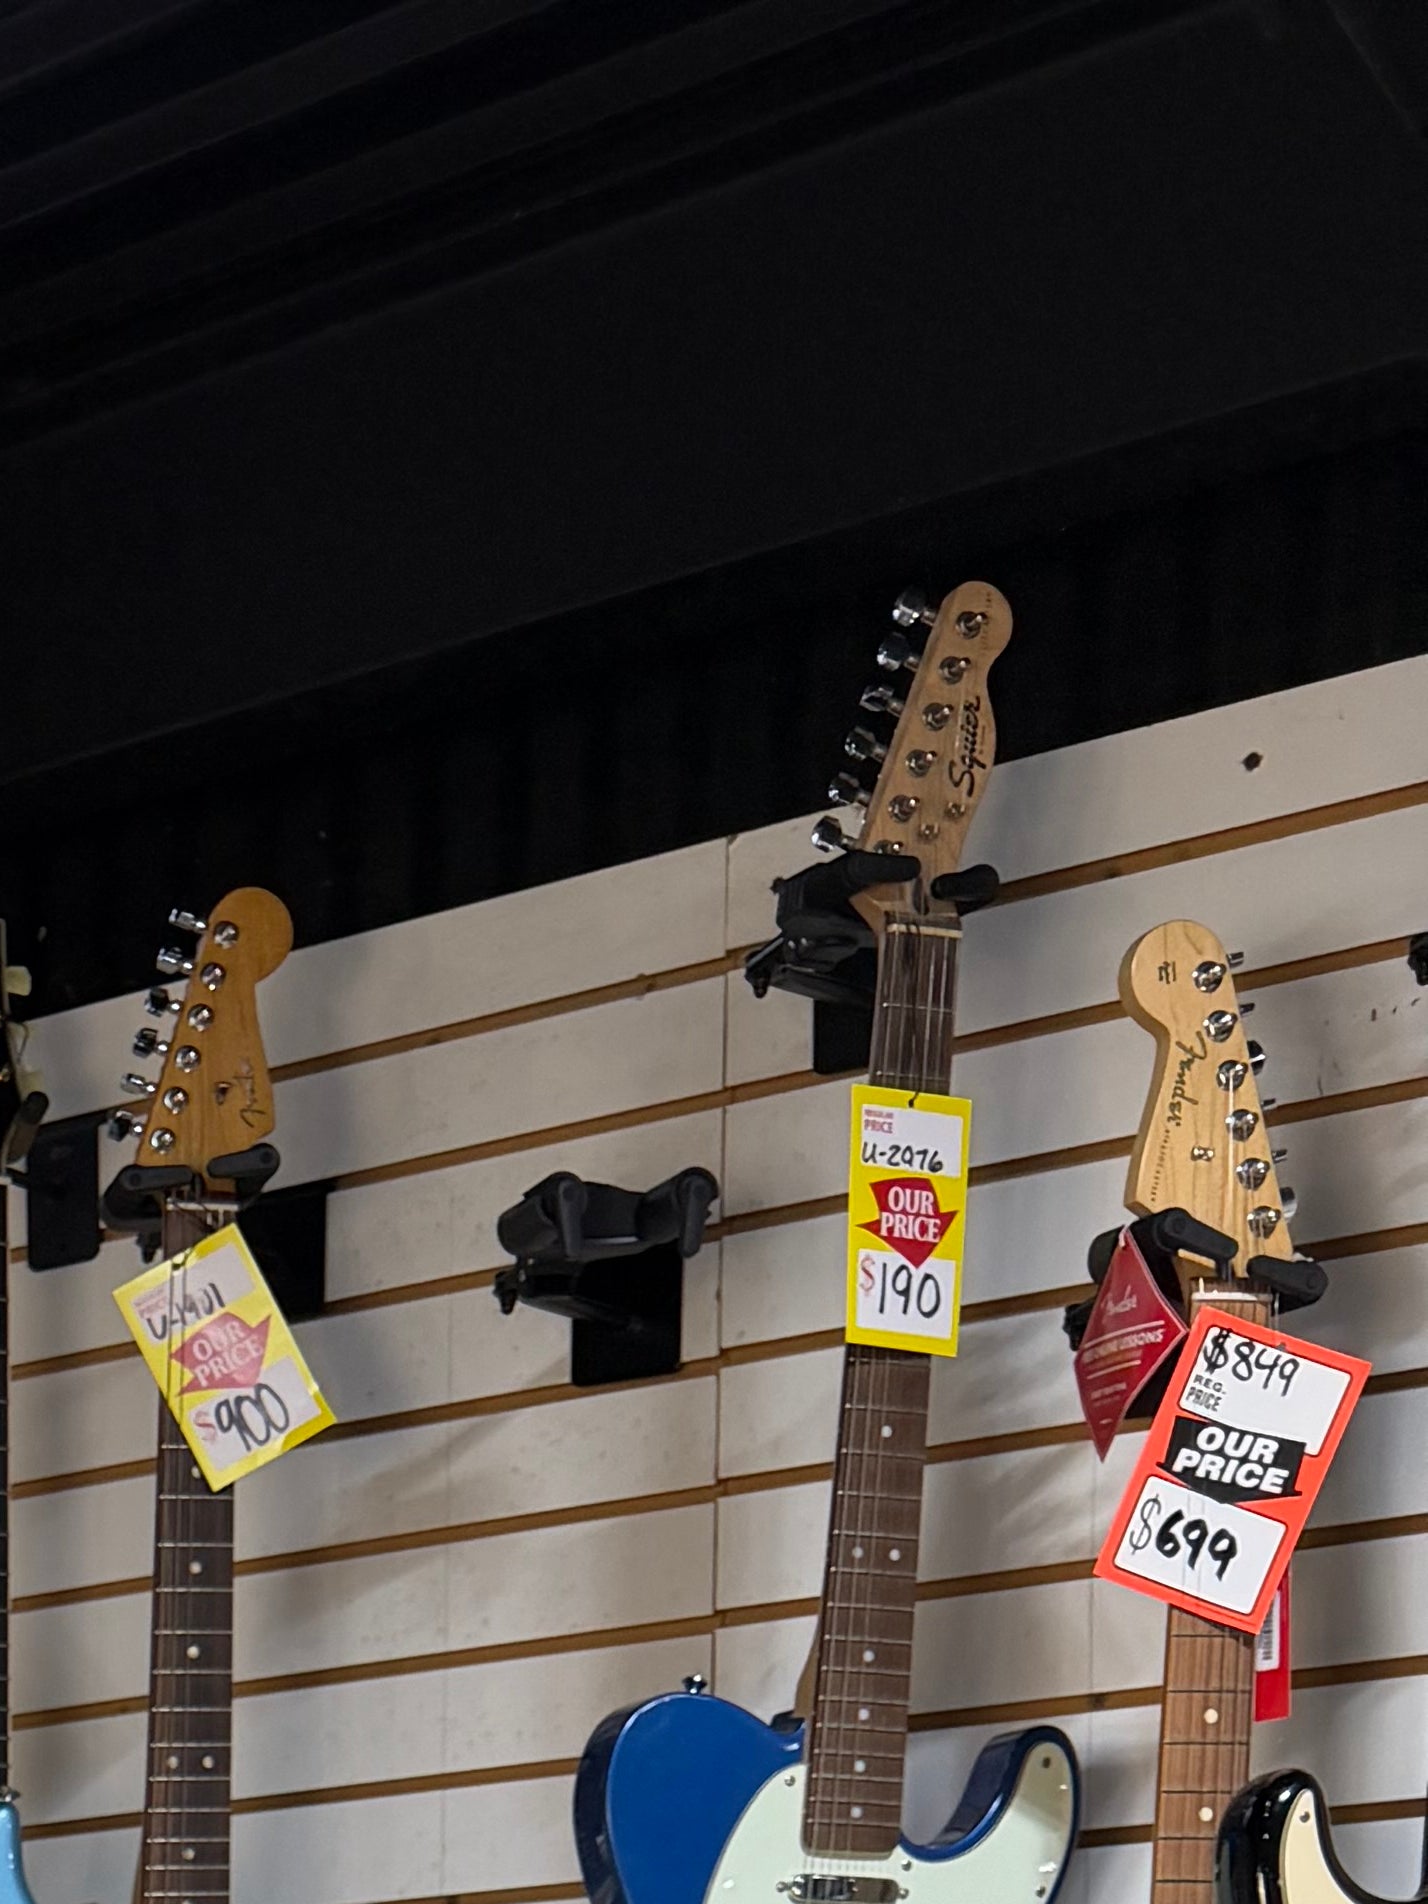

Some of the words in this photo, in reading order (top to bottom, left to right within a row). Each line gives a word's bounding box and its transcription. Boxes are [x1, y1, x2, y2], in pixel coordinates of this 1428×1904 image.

[948, 695, 987, 798] Squier
[1155, 1030, 1208, 1127] Fender
[864, 1118, 894, 1135] PRICE
[887, 1185, 934, 1217] OUR
[879, 1212, 942, 1243] PRICE
[858, 1253, 942, 1320] $190
[192, 1319, 248, 1361] OUR
[194, 1335, 263, 1388] PRICE
[1203, 1328, 1301, 1397] $849
[1185, 1386, 1222, 1414] PRICE
[1191, 1373, 1228, 1398] REG.
[194, 1382, 292, 1452] $900
[1195, 1424, 1280, 1465] OUR
[1171, 1448, 1292, 1495] PRICE
[1129, 1493, 1239, 1582] $699
